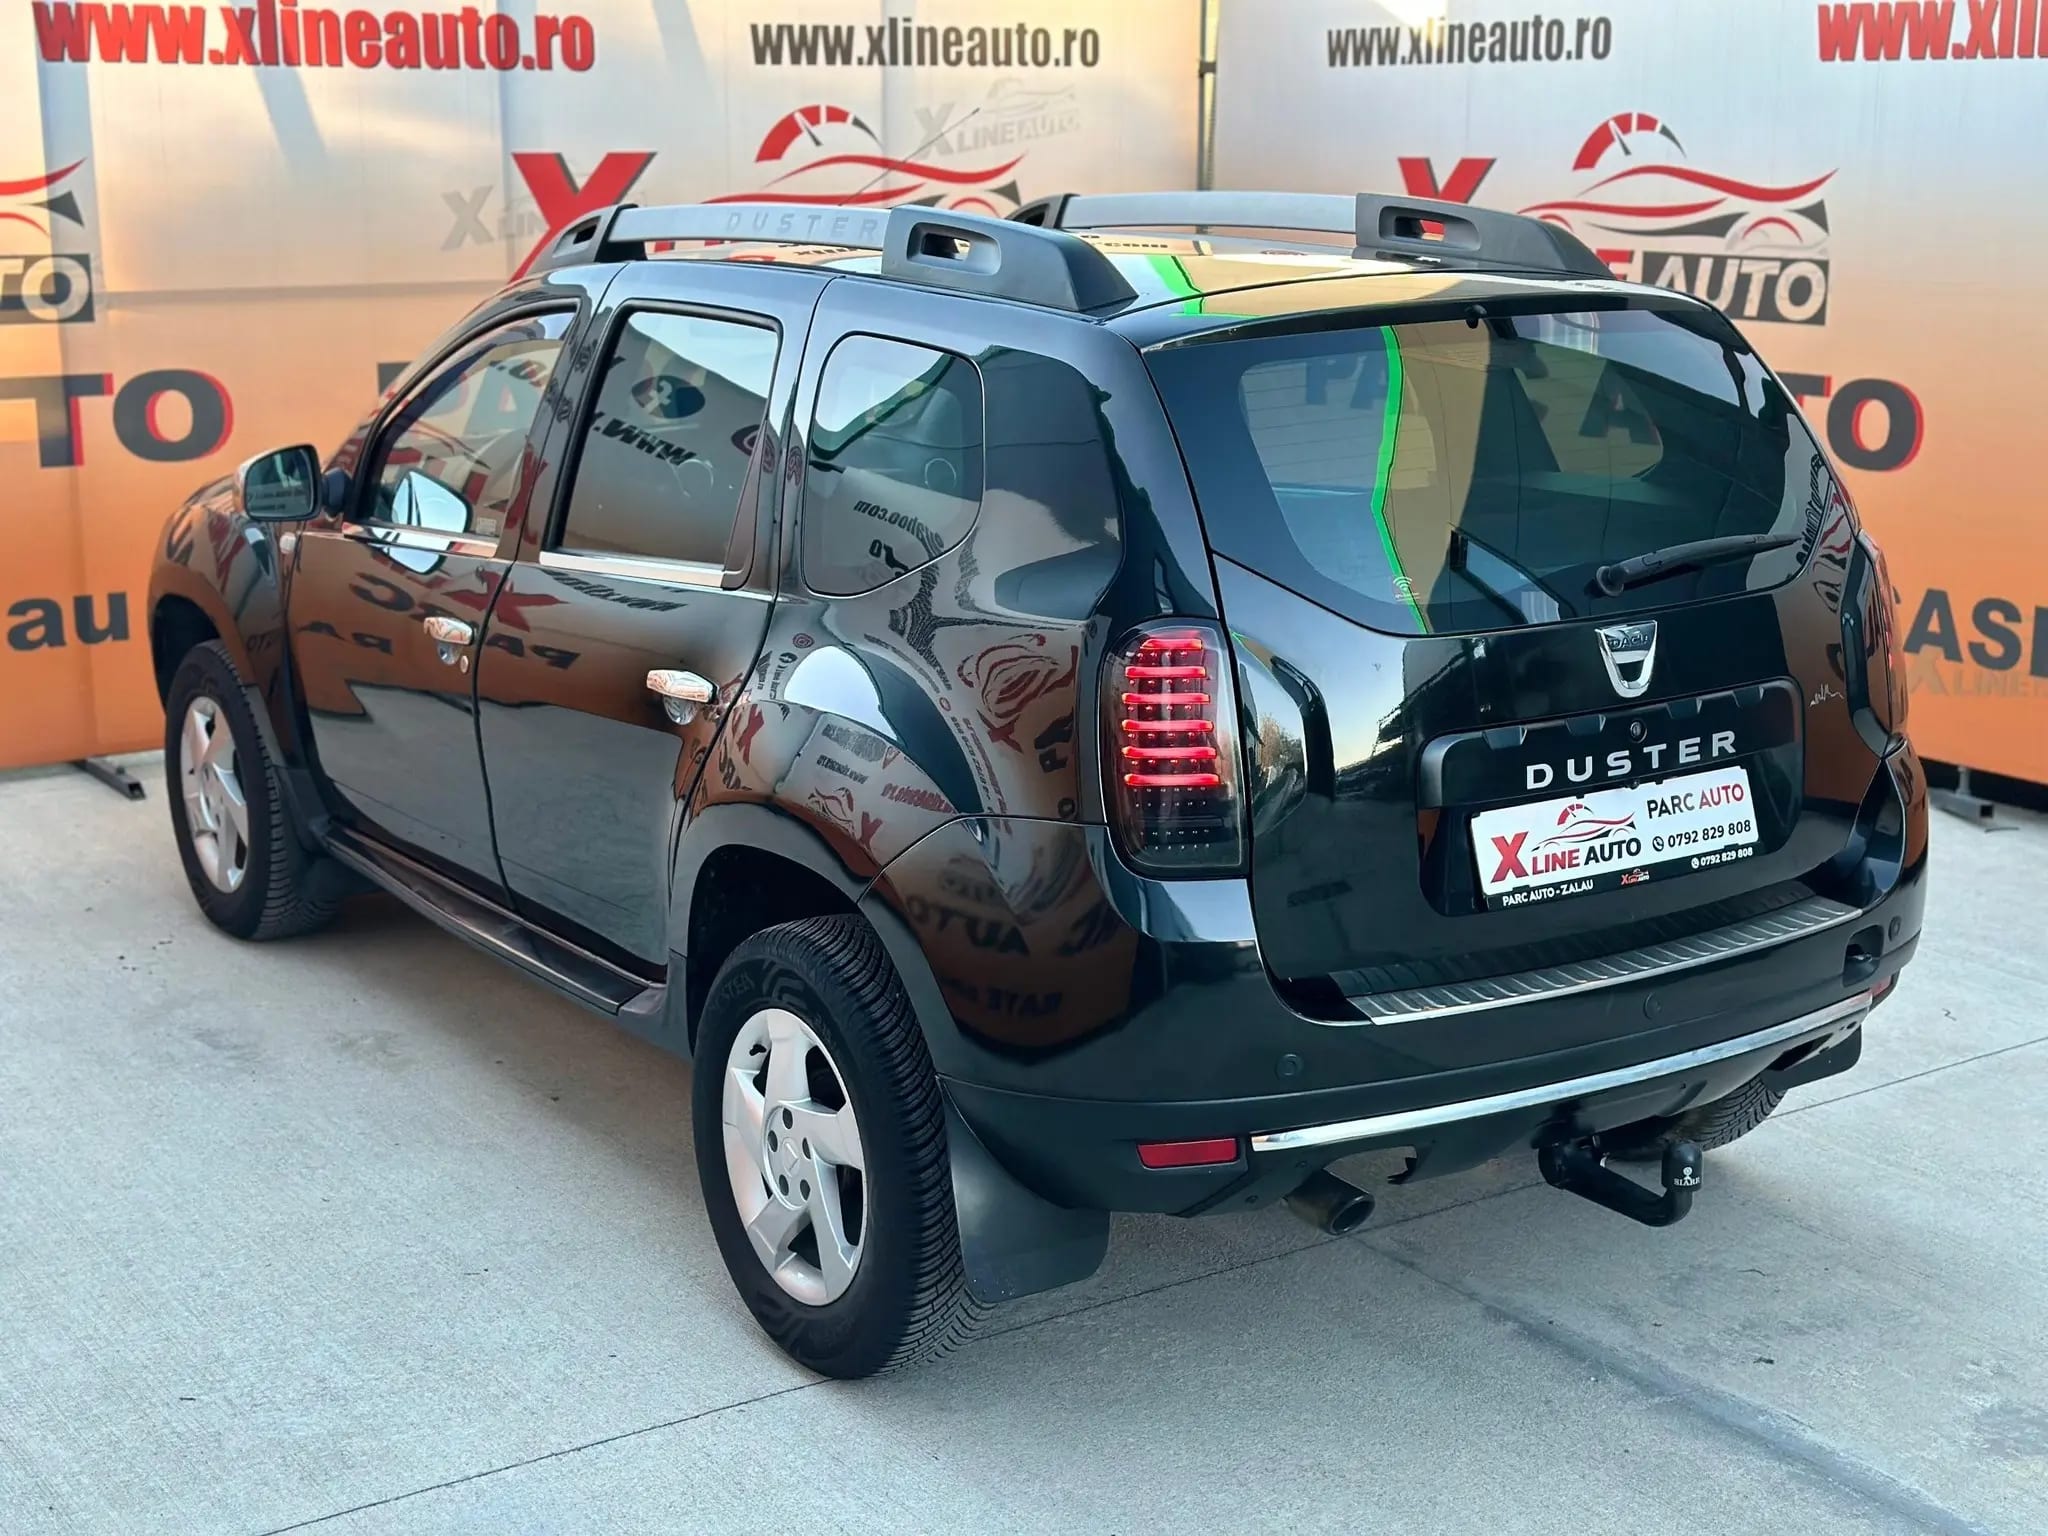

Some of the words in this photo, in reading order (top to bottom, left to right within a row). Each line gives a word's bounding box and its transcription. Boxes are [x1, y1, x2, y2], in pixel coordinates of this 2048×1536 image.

[32, 0, 596, 71] www.xlineauto.ro
[751, 16, 1100, 68] www.xlineauto.ro
[1327, 14, 1612, 67] www.xlineauto.ro
[726, 211, 878, 240] DUSTER
[1651, 255, 1827, 322] AUTO
[7, 591, 130, 652] au
[1526, 730, 1736, 790] DUSTER
[1646, 791, 1695, 819] PARC
[1699, 783, 1744, 809] AUTO
[1584, 837, 1642, 866] AUTO
[1667, 830, 1699, 848] 0792
[1702, 824, 1725, 841] 829
[1728, 819, 1752, 836] 808
[1700, 854, 1721, 867] 0792
[1721, 850, 1737, 863] 829
[1737, 846, 1754, 859] 808
[1502, 892, 1529, 907] PARC
[1529, 886, 1555, 902] AUTO
[1562, 879, 1594, 895] ZALAU
